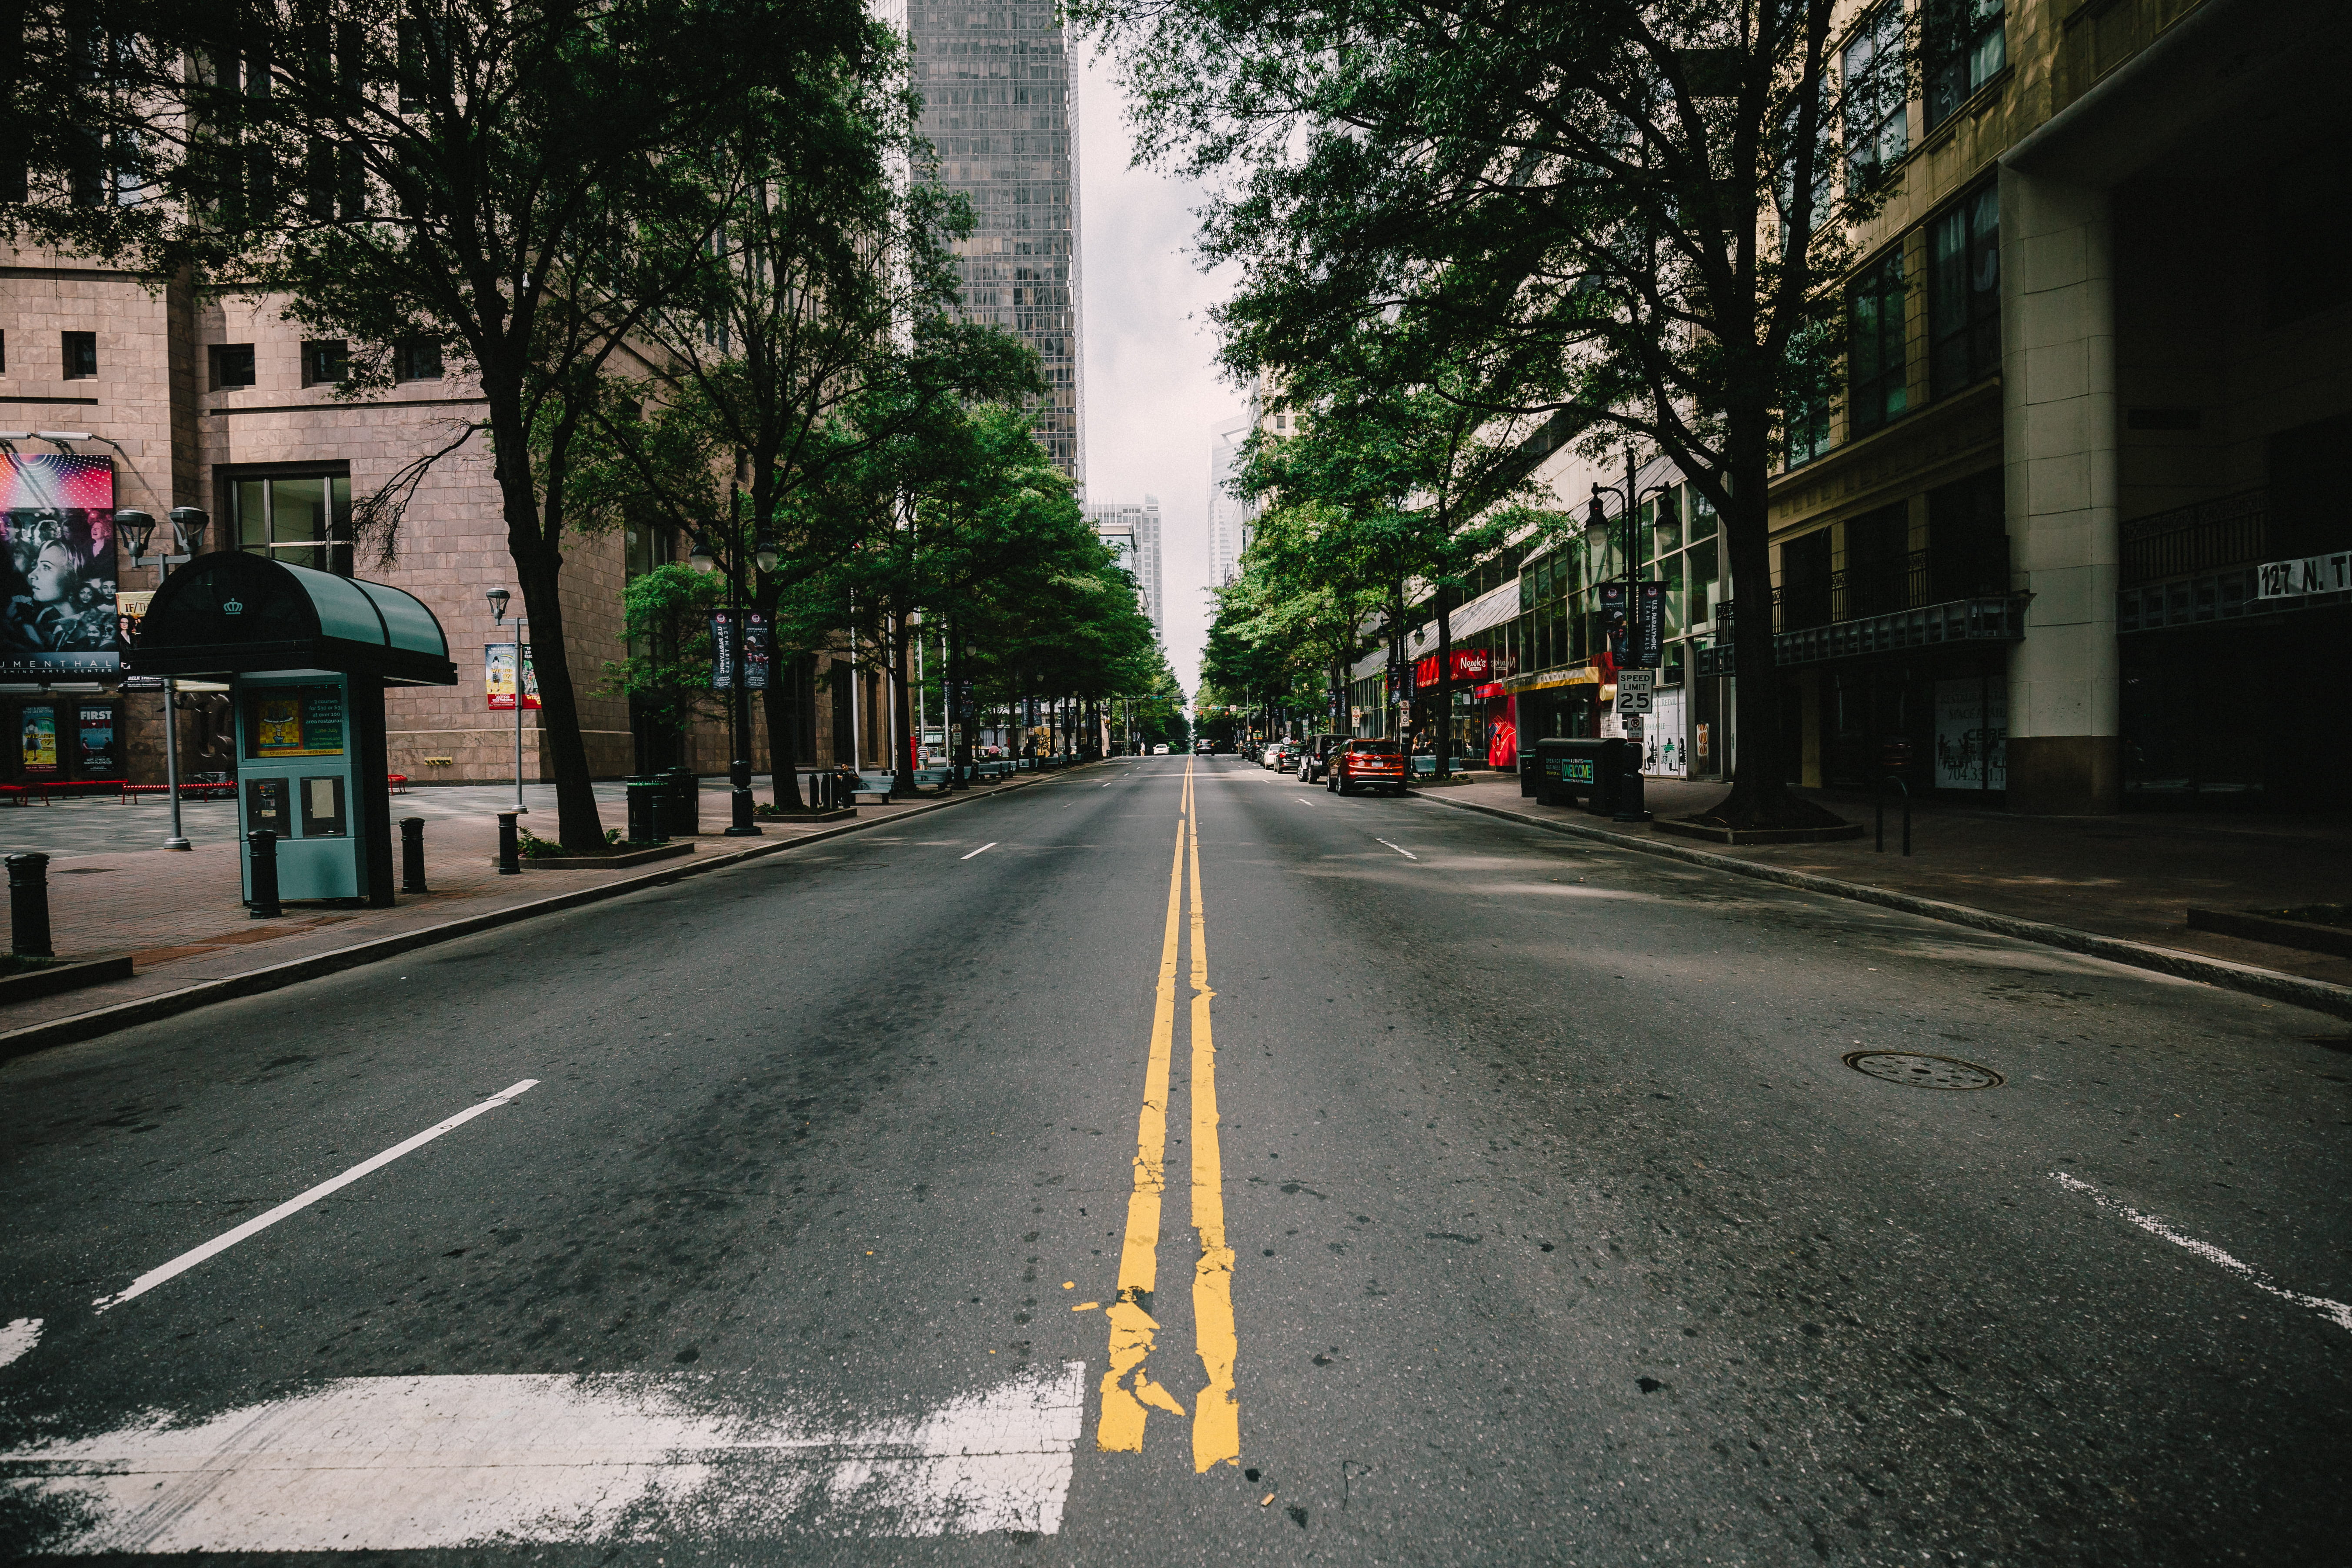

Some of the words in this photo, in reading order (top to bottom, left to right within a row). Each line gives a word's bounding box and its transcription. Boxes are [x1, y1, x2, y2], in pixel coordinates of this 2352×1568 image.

[2262, 564, 2291, 596] 127
[2302, 560, 2323, 592] N.
[1460, 656, 1486, 669] Newk's
[1620, 693, 1649, 708] 25
[80, 711, 112, 720] FIRST
[80, 720, 111, 729] DATE
[1564, 764, 1591, 778] WELCOME
